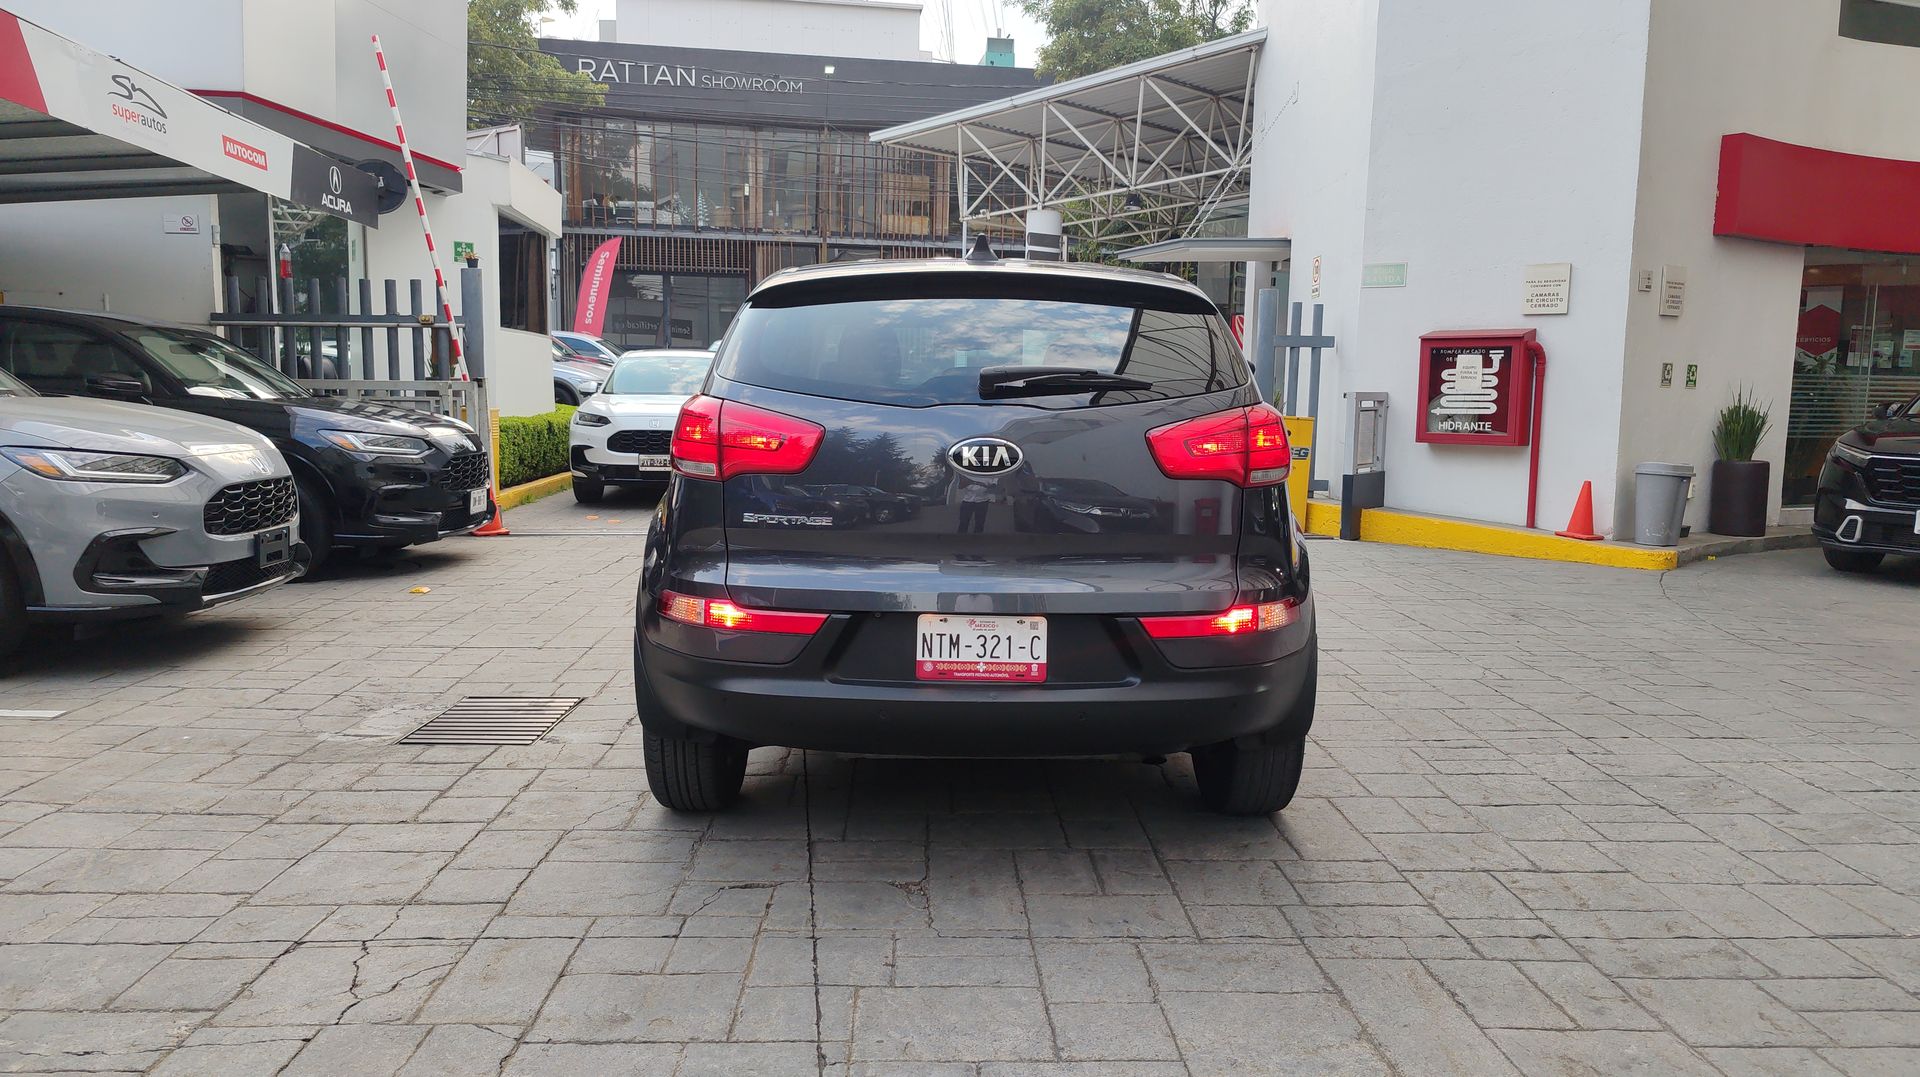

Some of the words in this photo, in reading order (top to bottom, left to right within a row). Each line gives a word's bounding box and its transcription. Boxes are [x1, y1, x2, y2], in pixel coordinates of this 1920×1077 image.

[578, 58, 696, 87] RATTAN
[701, 74, 803, 94] SHOWROOM
[111, 103, 167, 134] superautos
[225, 141, 267, 167] AUTOCOM
[321, 192, 353, 215] ACURA
[584, 250, 610, 325] Seminuevos
[1438, 421, 1492, 431] HIDRANTE
[962, 446, 1012, 467] KIA
[742, 512, 833, 526] SPORTAGE
[921, 633, 1041, 660] NTM-321-C
